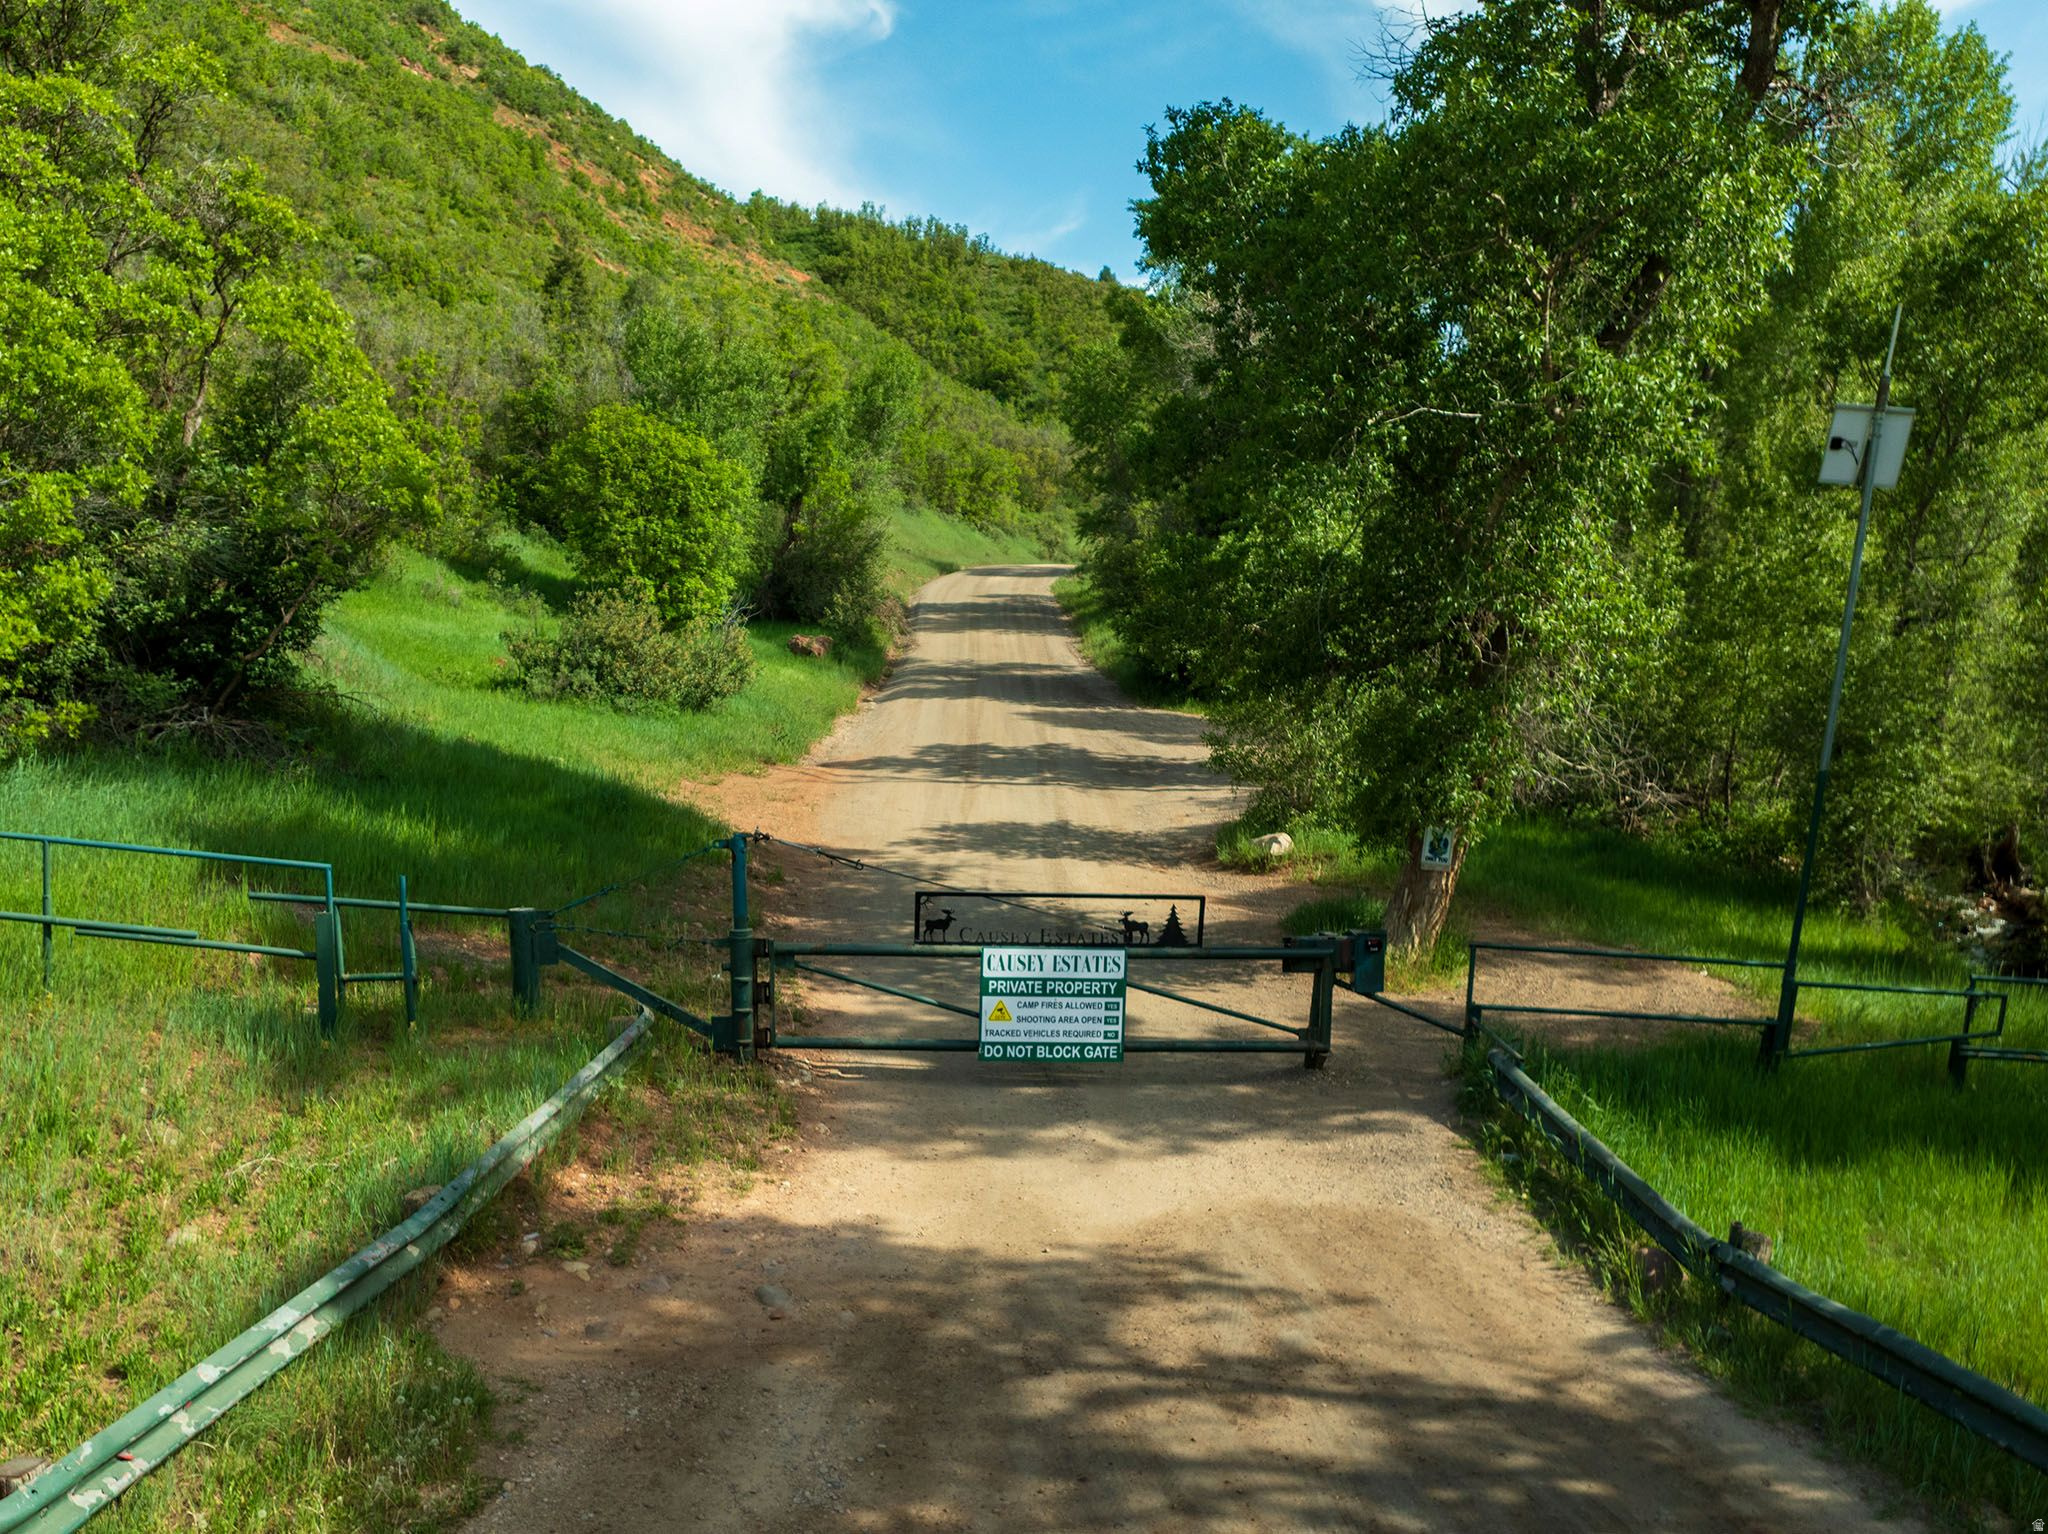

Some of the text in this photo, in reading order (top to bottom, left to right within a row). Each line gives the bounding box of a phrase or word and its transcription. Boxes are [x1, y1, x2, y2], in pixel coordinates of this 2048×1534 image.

[959, 927, 1120, 944] CAUSEY ESTATES
[987, 954, 1121, 973] CAUSEY ESTATES
[989, 981, 1117, 994] PRIVATE PROPERTY
[1017, 1001, 1039, 1009] CAMP
[1065, 1002, 1103, 1010] ALLOWED
[1081, 1016, 1102, 1024] OPEN
[985, 1029, 1021, 1037] TRACKED
[1063, 1030, 1101, 1038] REQUIRED
[984, 1045, 1117, 1058] DO NOT BLOCK GATE
